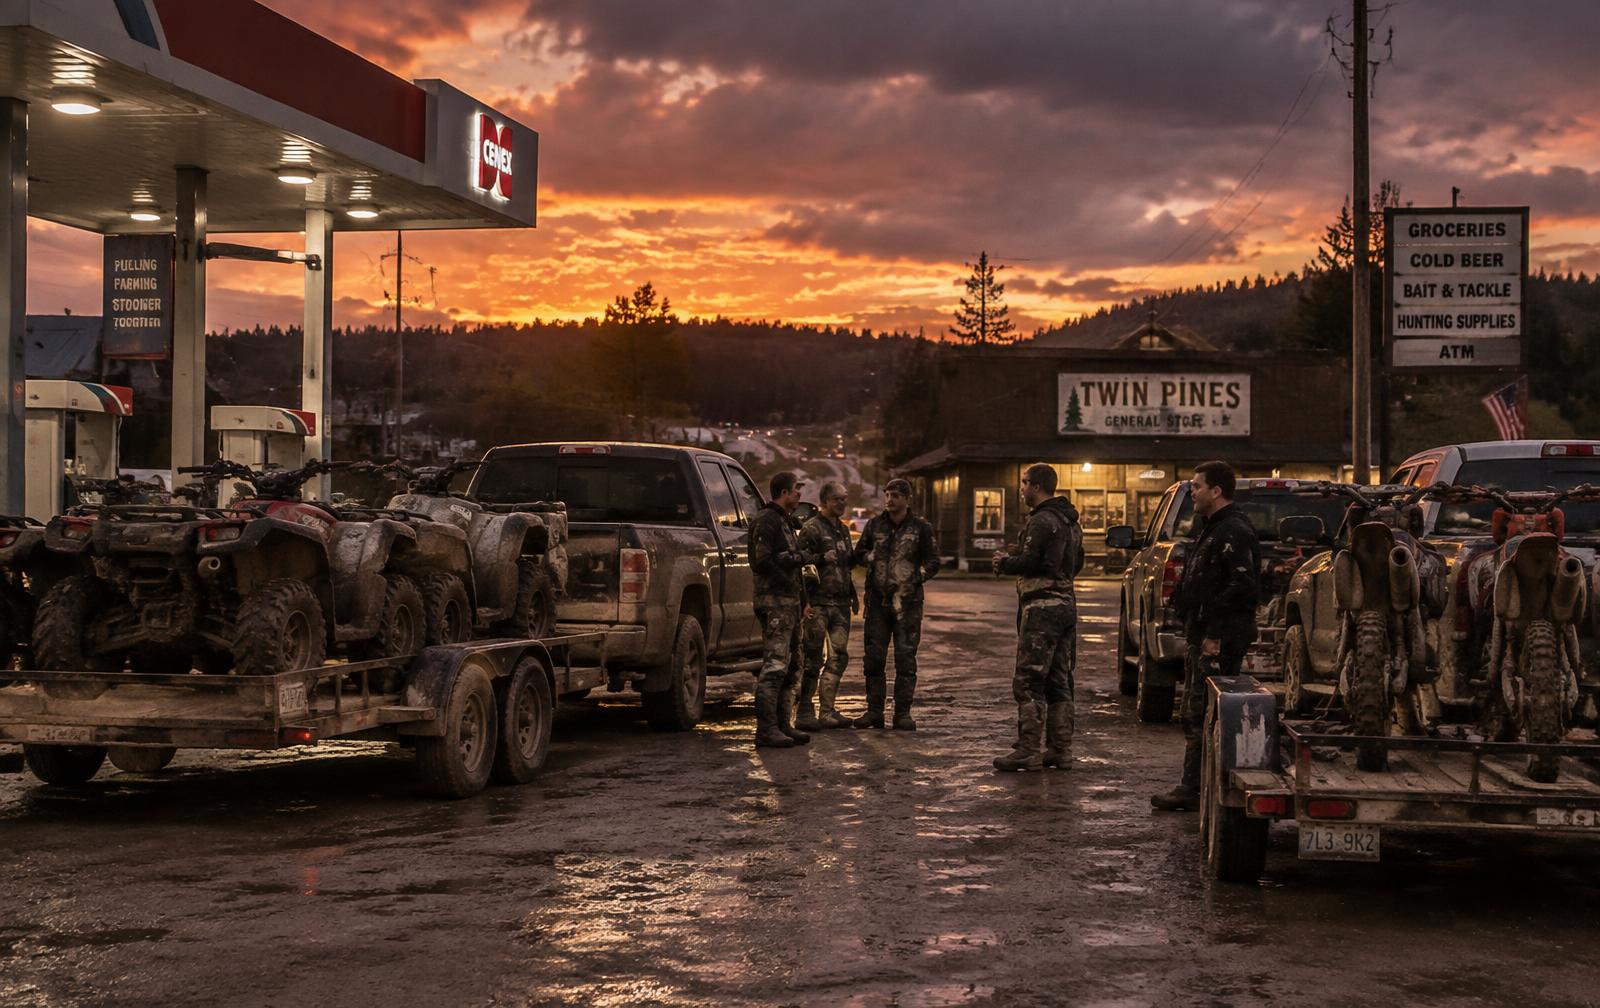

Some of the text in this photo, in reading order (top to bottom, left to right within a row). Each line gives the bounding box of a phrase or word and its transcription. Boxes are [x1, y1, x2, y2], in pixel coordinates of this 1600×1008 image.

[483, 139, 512, 175] CENEX
[1408, 222, 1506, 238] GROCERIES
[1410, 253, 1504, 268] COLD BEER
[1403, 283, 1511, 298] BAIT & TACKLE
[1398, 314, 1516, 329] HUNTING SUPPLIES
[1439, 345, 1475, 359] ATM
[1081, 379, 1241, 409] TWIN PINES
[1105, 415, 1160, 427] GENERAL
[1305, 832, 1375, 851] 7L3 9K2
